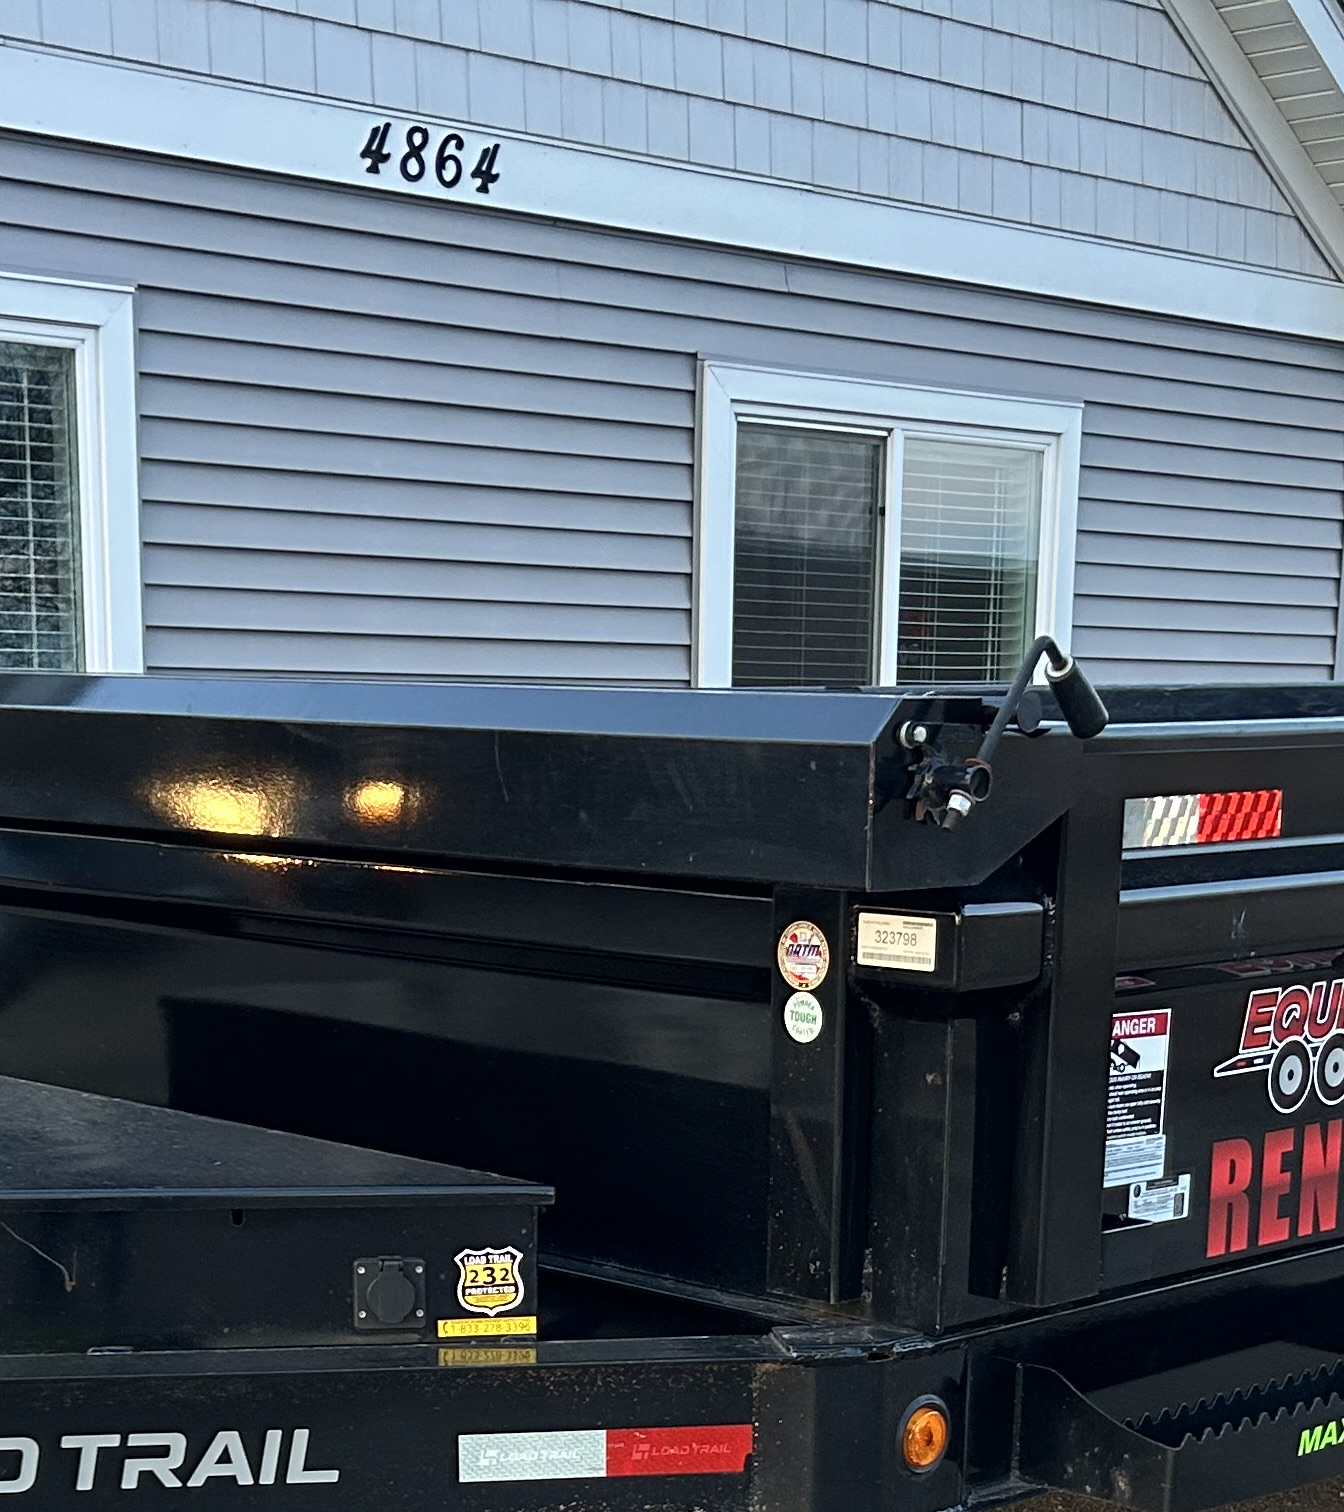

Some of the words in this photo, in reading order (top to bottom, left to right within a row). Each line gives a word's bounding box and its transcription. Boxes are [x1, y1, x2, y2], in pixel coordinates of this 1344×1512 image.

[359, 121, 501, 195] 4864
[874, 929, 918, 947] 323798
[1112, 1016, 1156, 1037] ANGER
[468, 1266, 510, 1285] 232
[59, 1428, 341, 1492] TRAIL
[651, 1445, 691, 1457] LOAD
[692, 1443, 732, 1455] TRAIL
